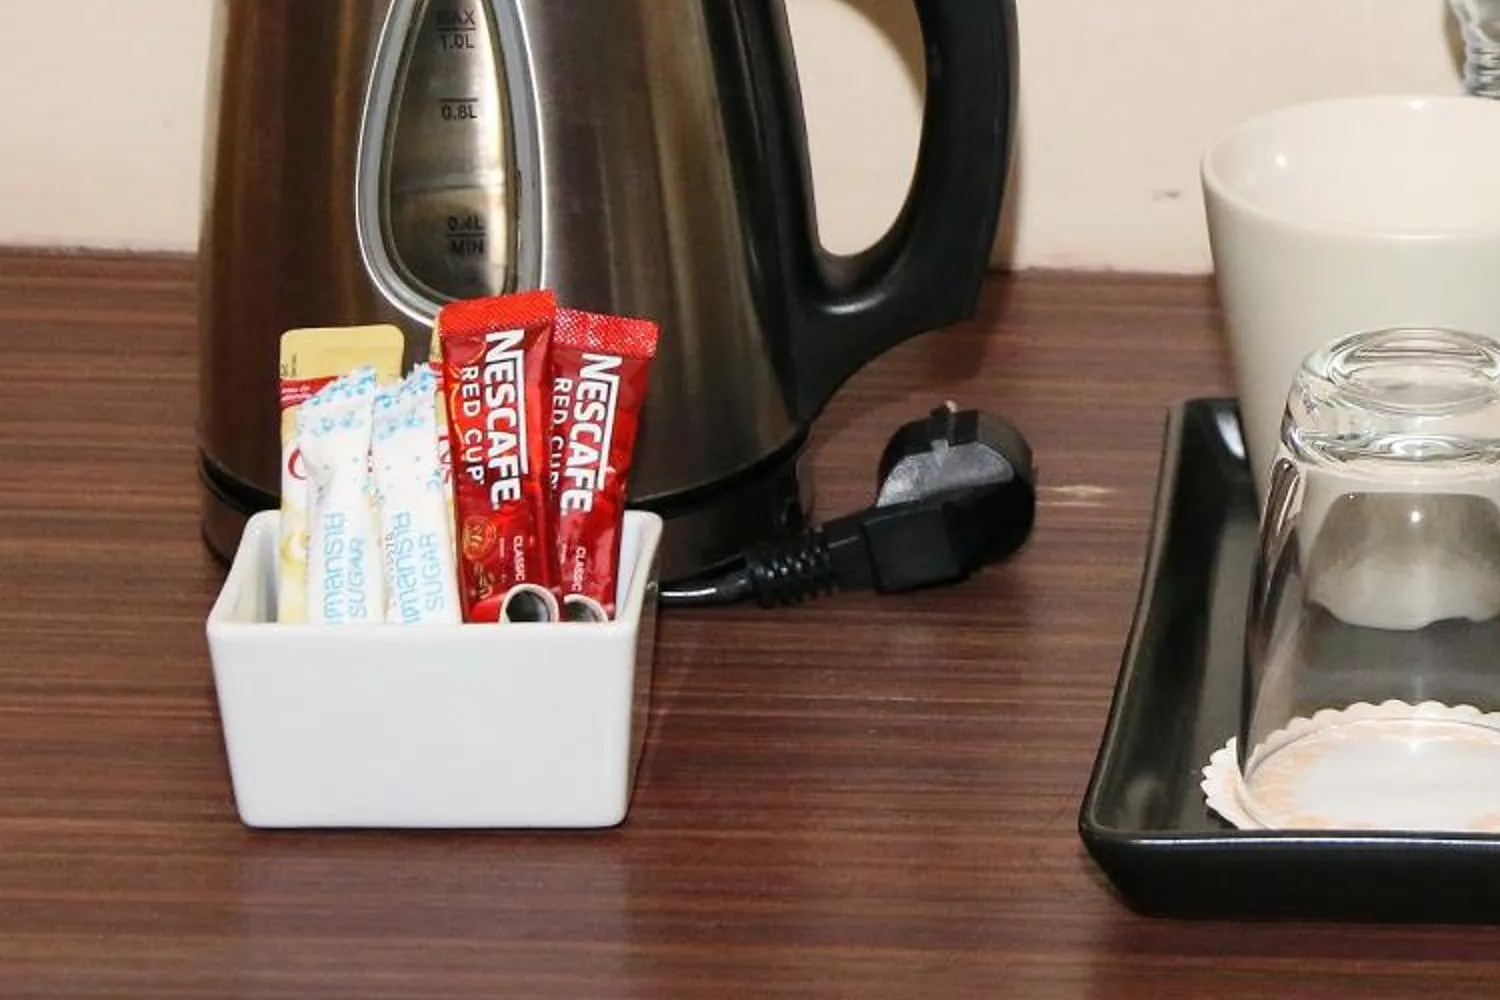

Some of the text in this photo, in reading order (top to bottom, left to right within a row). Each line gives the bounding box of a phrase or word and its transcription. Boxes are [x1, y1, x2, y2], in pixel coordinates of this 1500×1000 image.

[436, 8, 476, 26] MAX
[440, 33, 475, 51] 1.0L
[441, 102, 478, 121] 0.8L
[449, 237, 485, 255] MIN
[462, 365, 484, 482] RED CUP
[552, 376, 573, 425] RED
[347, 537, 368, 618] SUGAR
[419, 530, 445, 612] SUGAR
[513, 535, 526, 582] CLASSIC
[571, 546, 587, 592] CLASSIC
